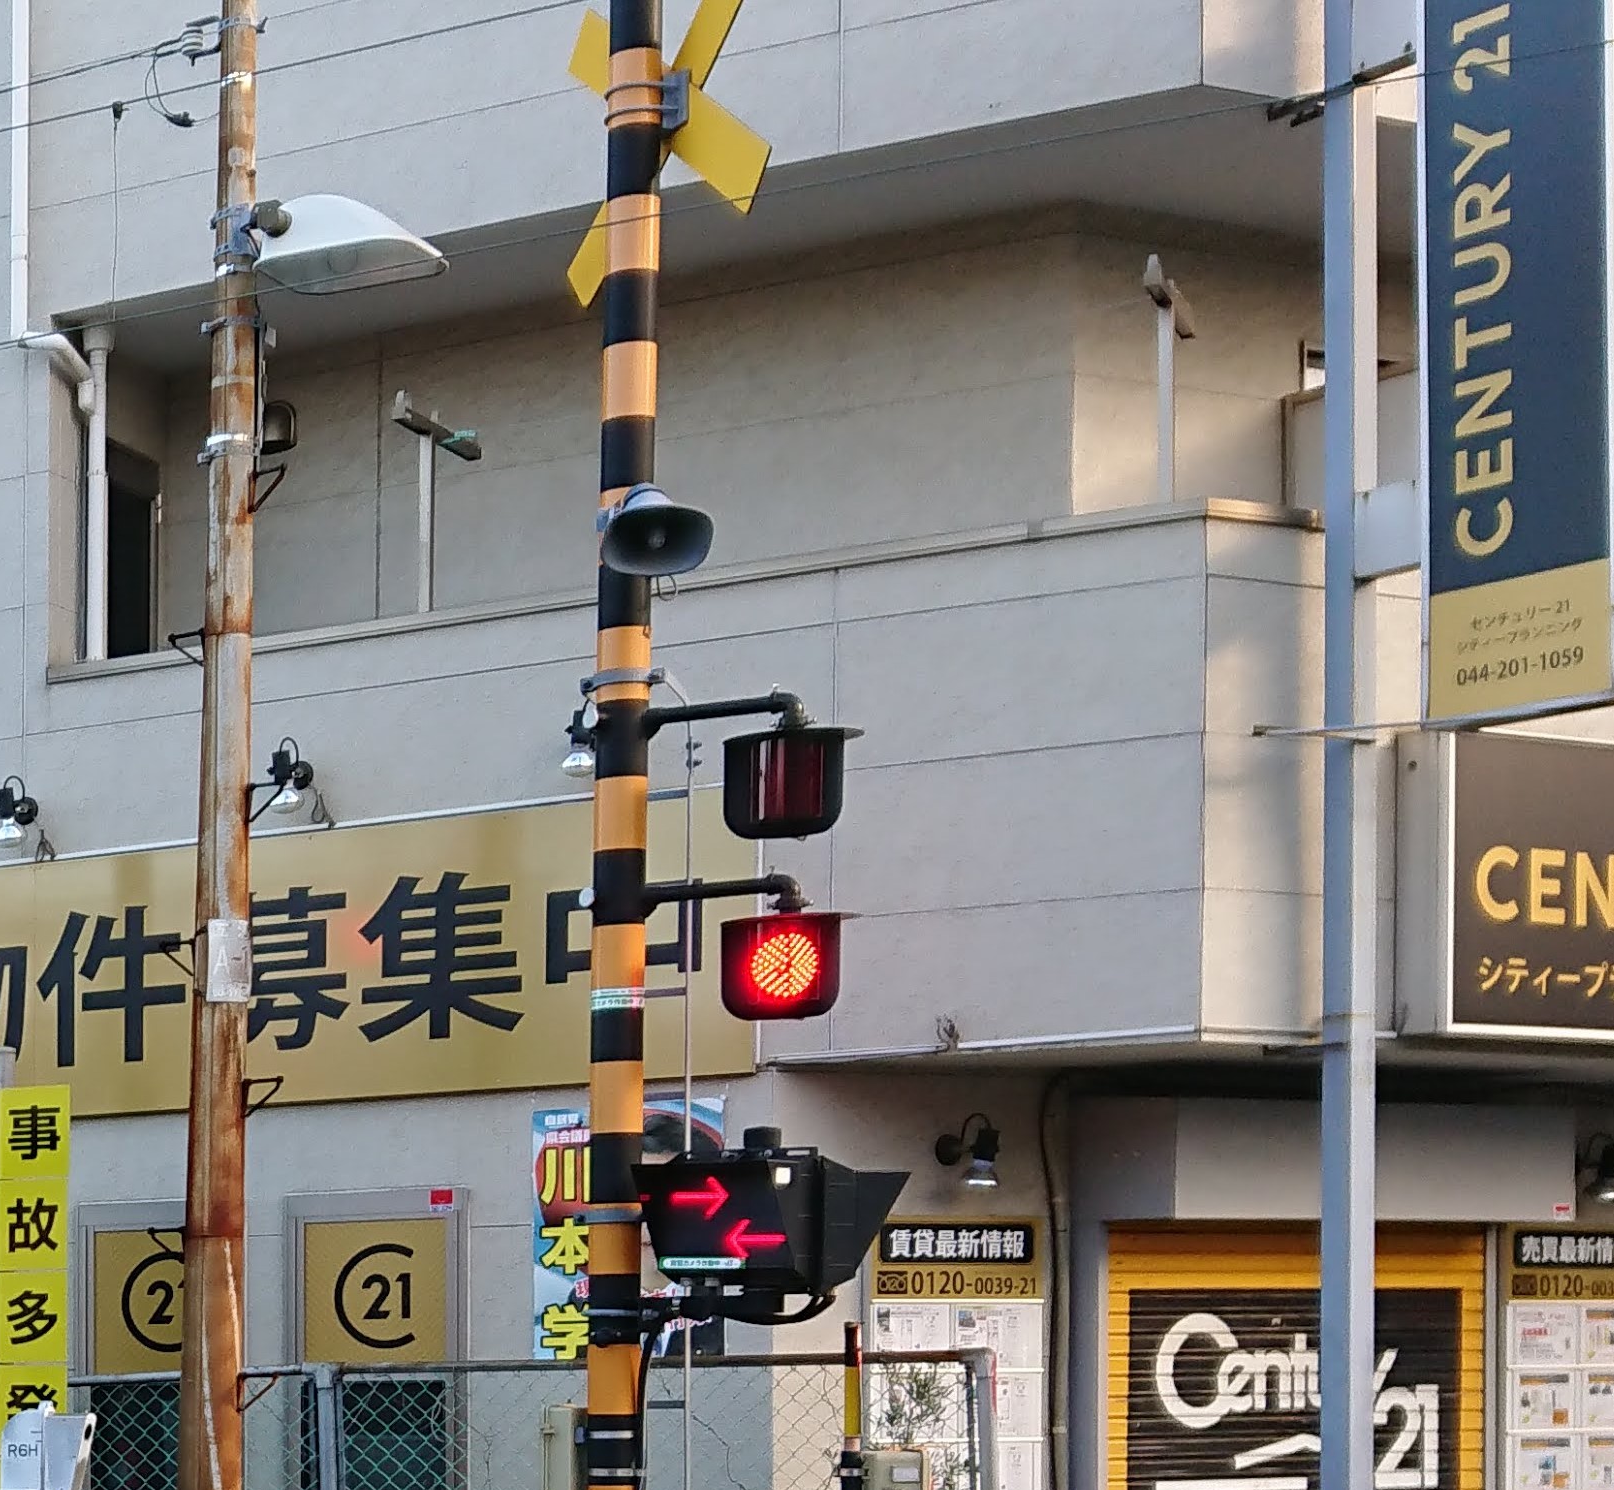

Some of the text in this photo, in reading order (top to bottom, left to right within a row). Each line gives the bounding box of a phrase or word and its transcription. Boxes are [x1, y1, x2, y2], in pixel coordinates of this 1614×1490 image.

[1453, 3, 1514, 558] CENTURY 21
[1455, 646, 1585, 686] 044-201-1059
[1476, 955, 1614, 999] シティープ
[888, 1228, 1026, 1260] 賃貸最新情報
[910, 1270, 1037, 1295] 0120-0039-21
[1155, 1312, 1400, 1429] Cent
[6, 1443, 39, 1459] R6H
[1373, 1383, 1440, 1490] 21
